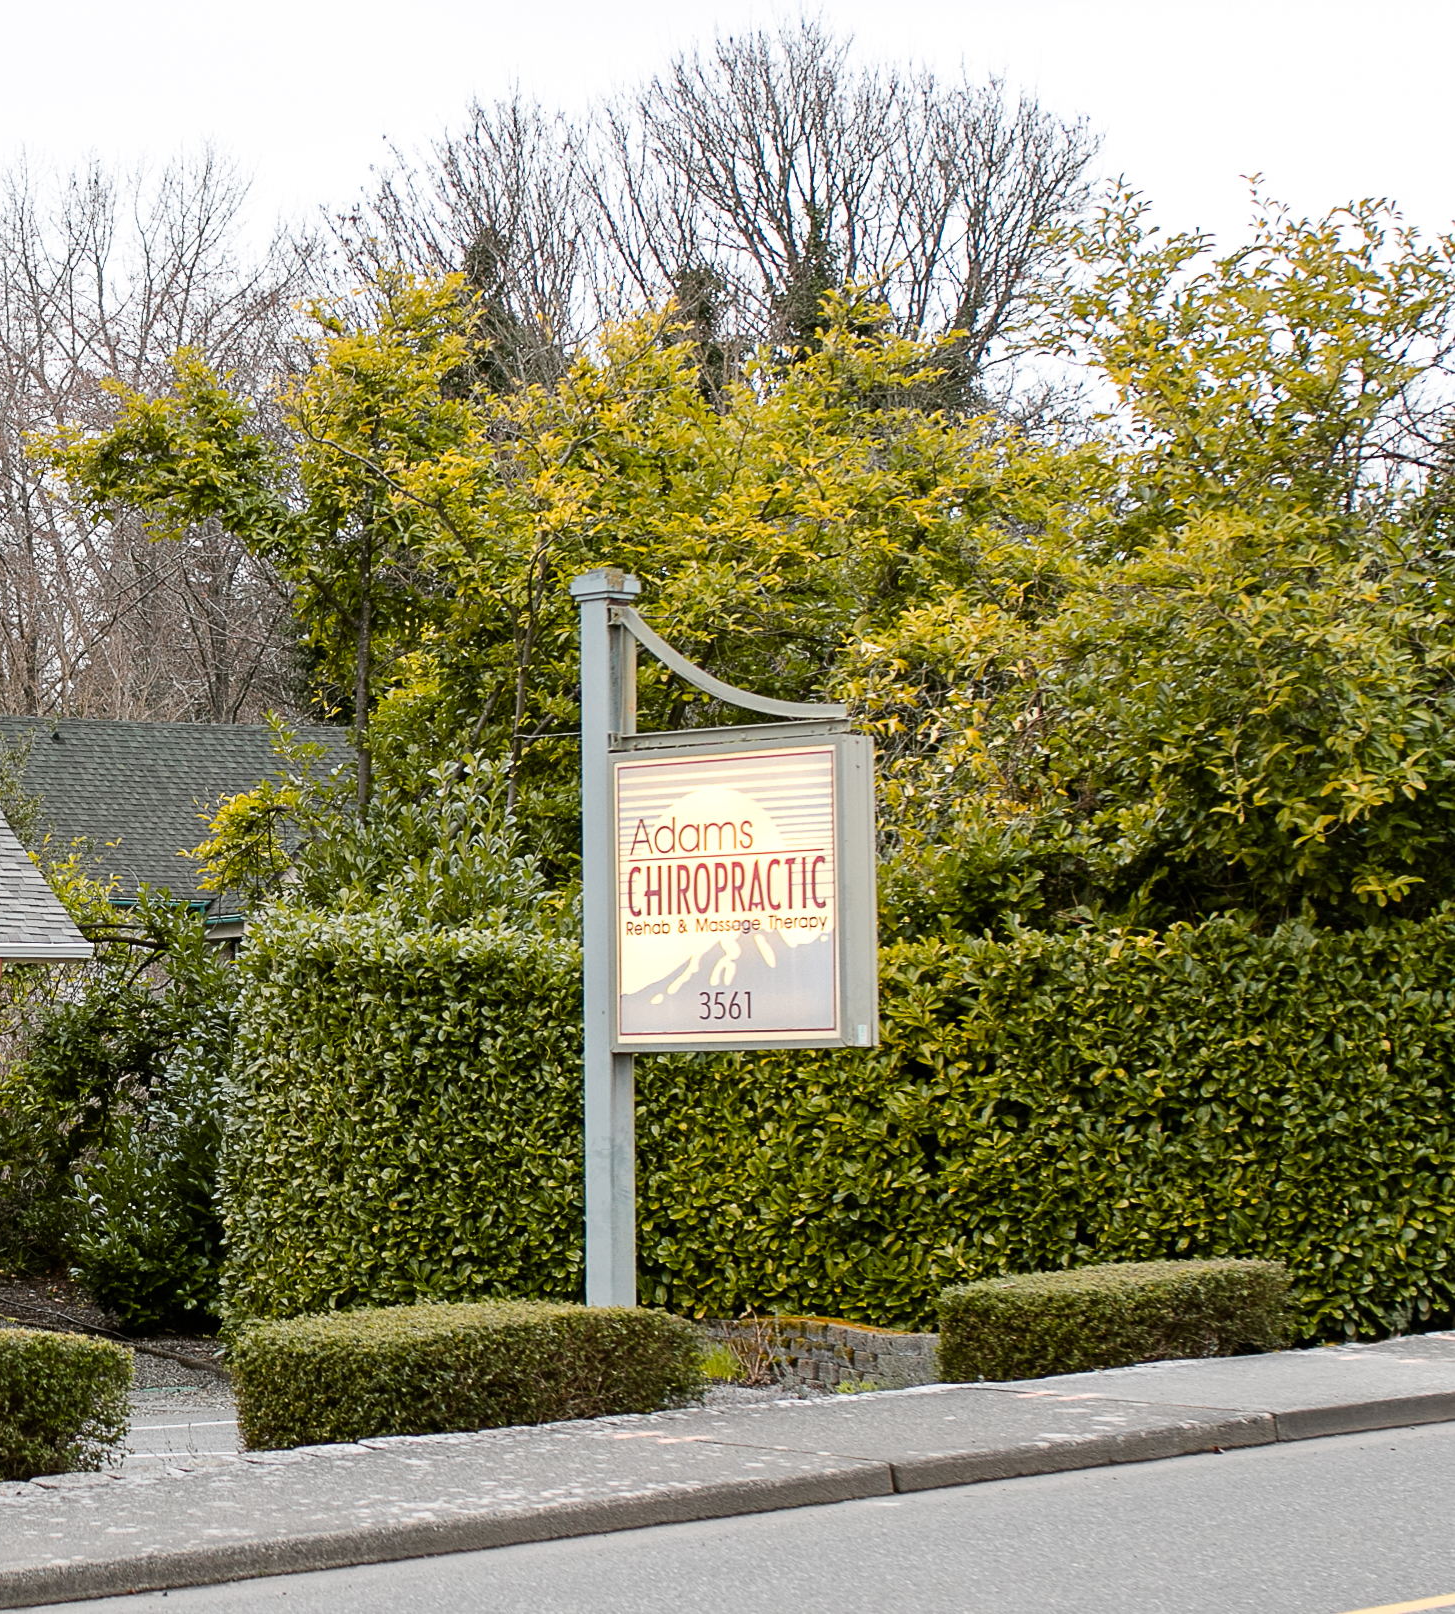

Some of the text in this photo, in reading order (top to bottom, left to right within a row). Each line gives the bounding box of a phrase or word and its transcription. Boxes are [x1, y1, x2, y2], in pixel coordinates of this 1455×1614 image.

[629, 817, 754, 856] Adams
[627, 856, 827, 917] CHIROPRACTIC
[626, 915, 828, 935] Rehab & Massage Therapy
[698, 991, 752, 1019] 3561
